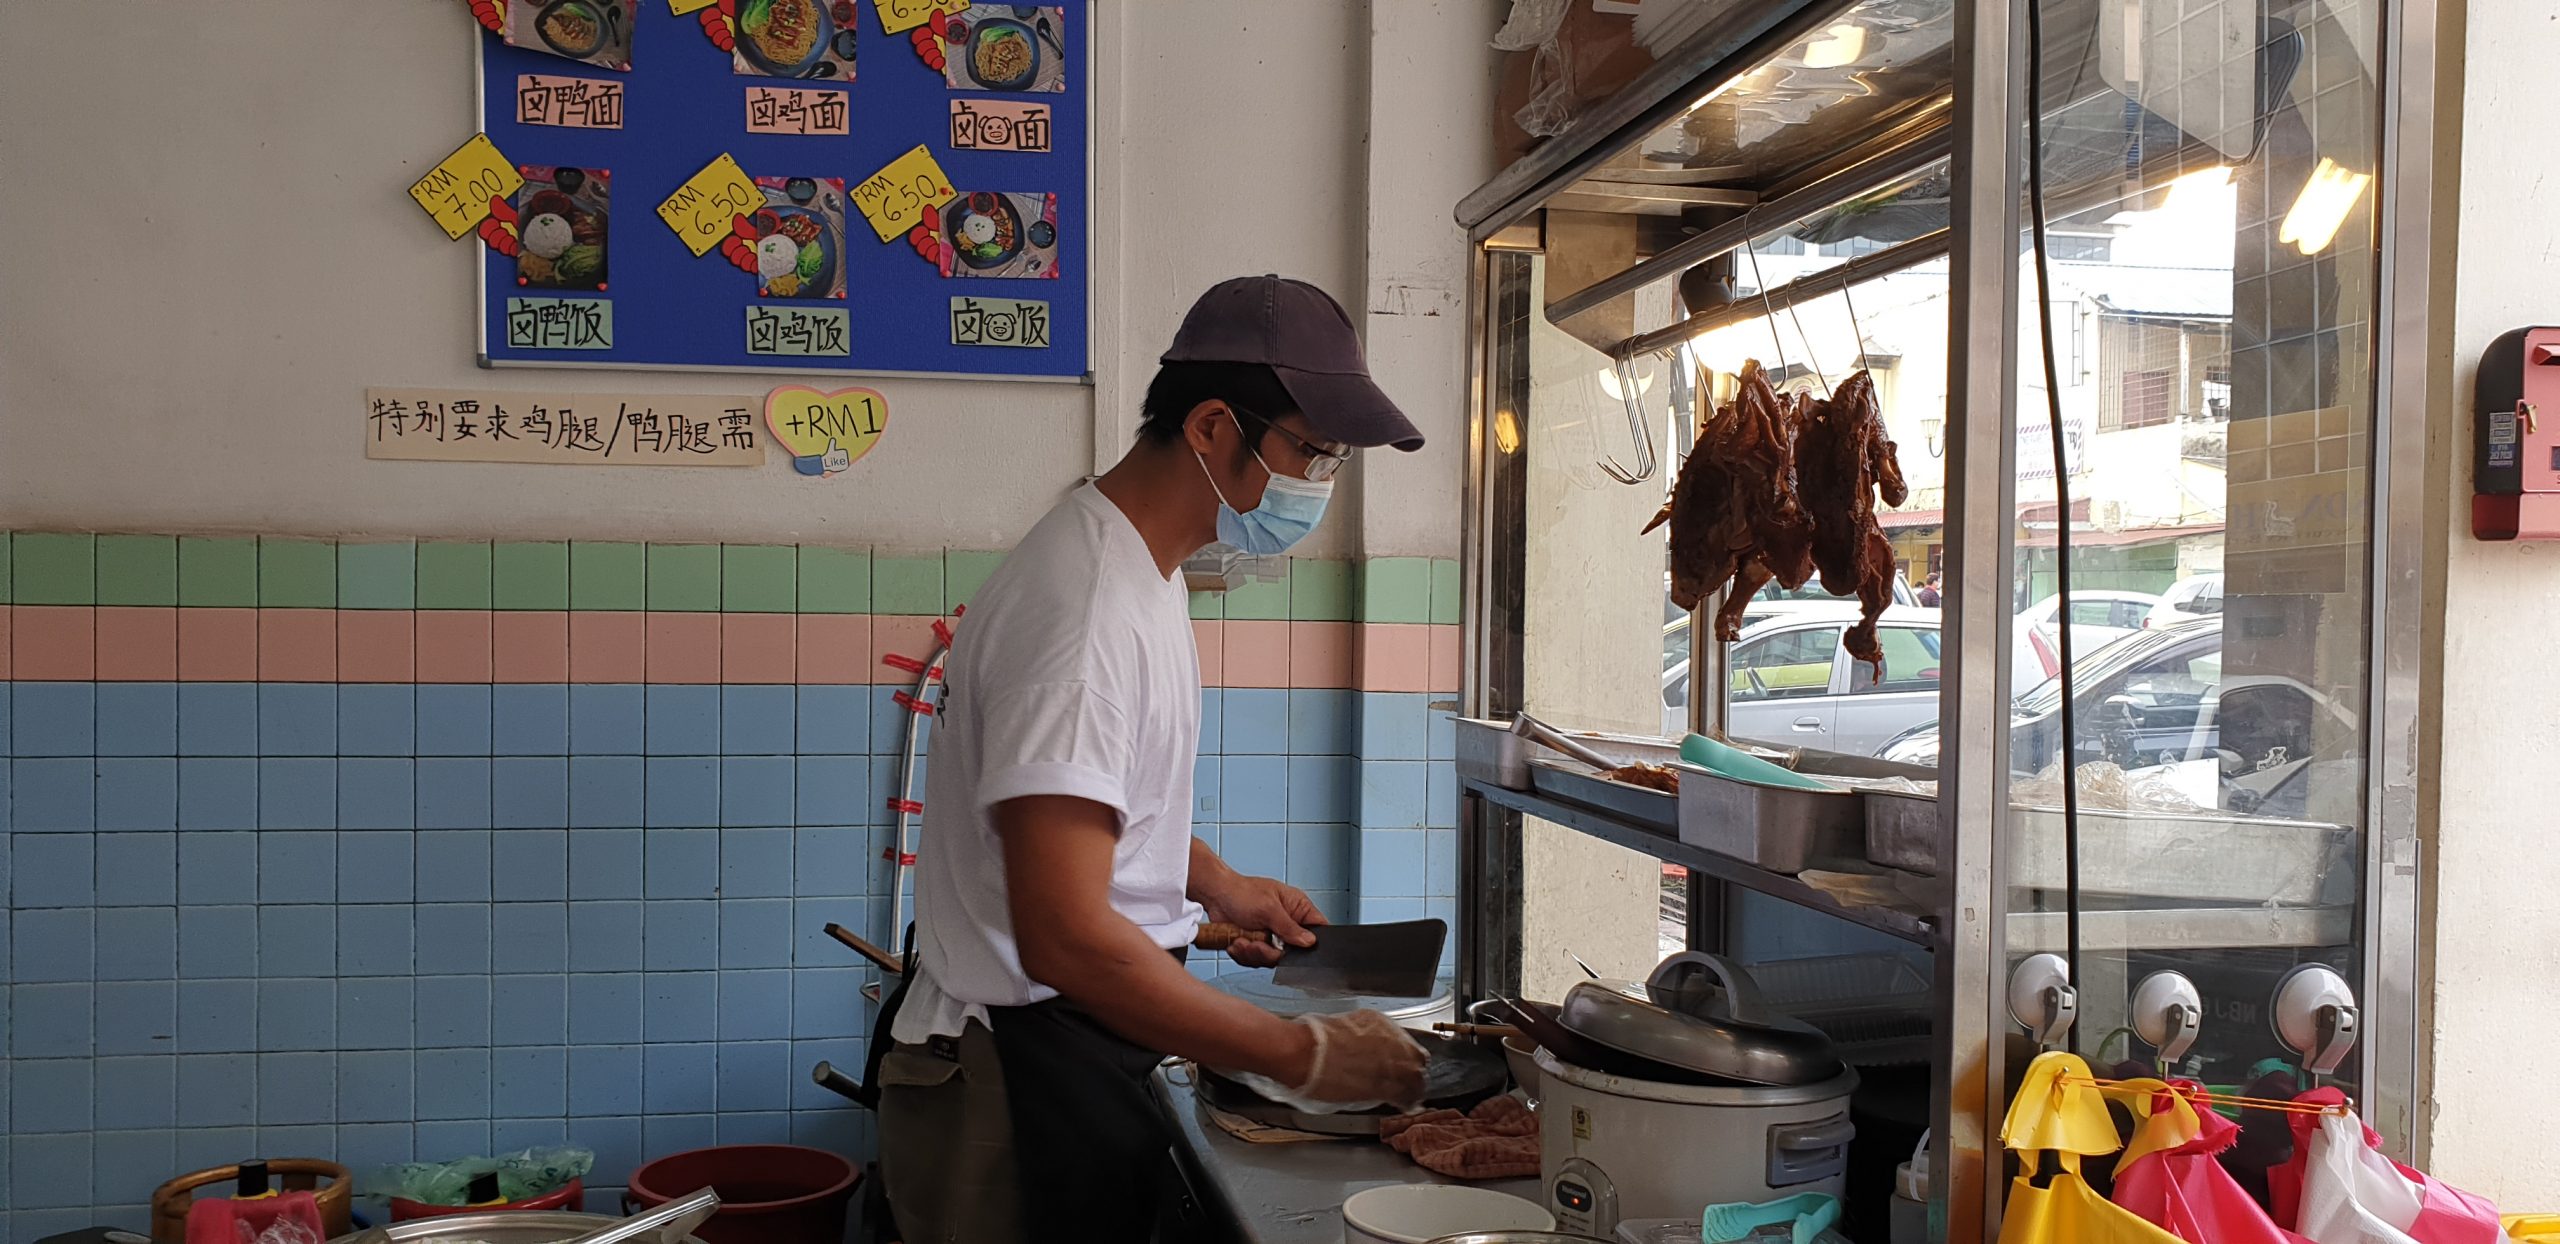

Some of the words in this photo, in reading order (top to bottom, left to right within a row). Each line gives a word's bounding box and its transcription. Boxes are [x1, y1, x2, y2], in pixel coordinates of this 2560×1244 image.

[520, 76, 622, 126] 卤鸭面
[750, 88, 845, 133] 卤鸡面
[420, 168, 459, 200] RM
[444, 168, 504, 222] 7.00
[667, 185, 705, 217] RM
[859, 175, 895, 203] RM
[883, 174, 937, 221] 6.50
[694, 182, 750, 235] 6.50
[508, 297, 611, 347] 卤鸭饭
[748, 306, 848, 353] 卤鸡饭
[369, 398, 755, 458] 特别要求鸡腿/鸭腿需
[824, 457, 846, 467] Like
